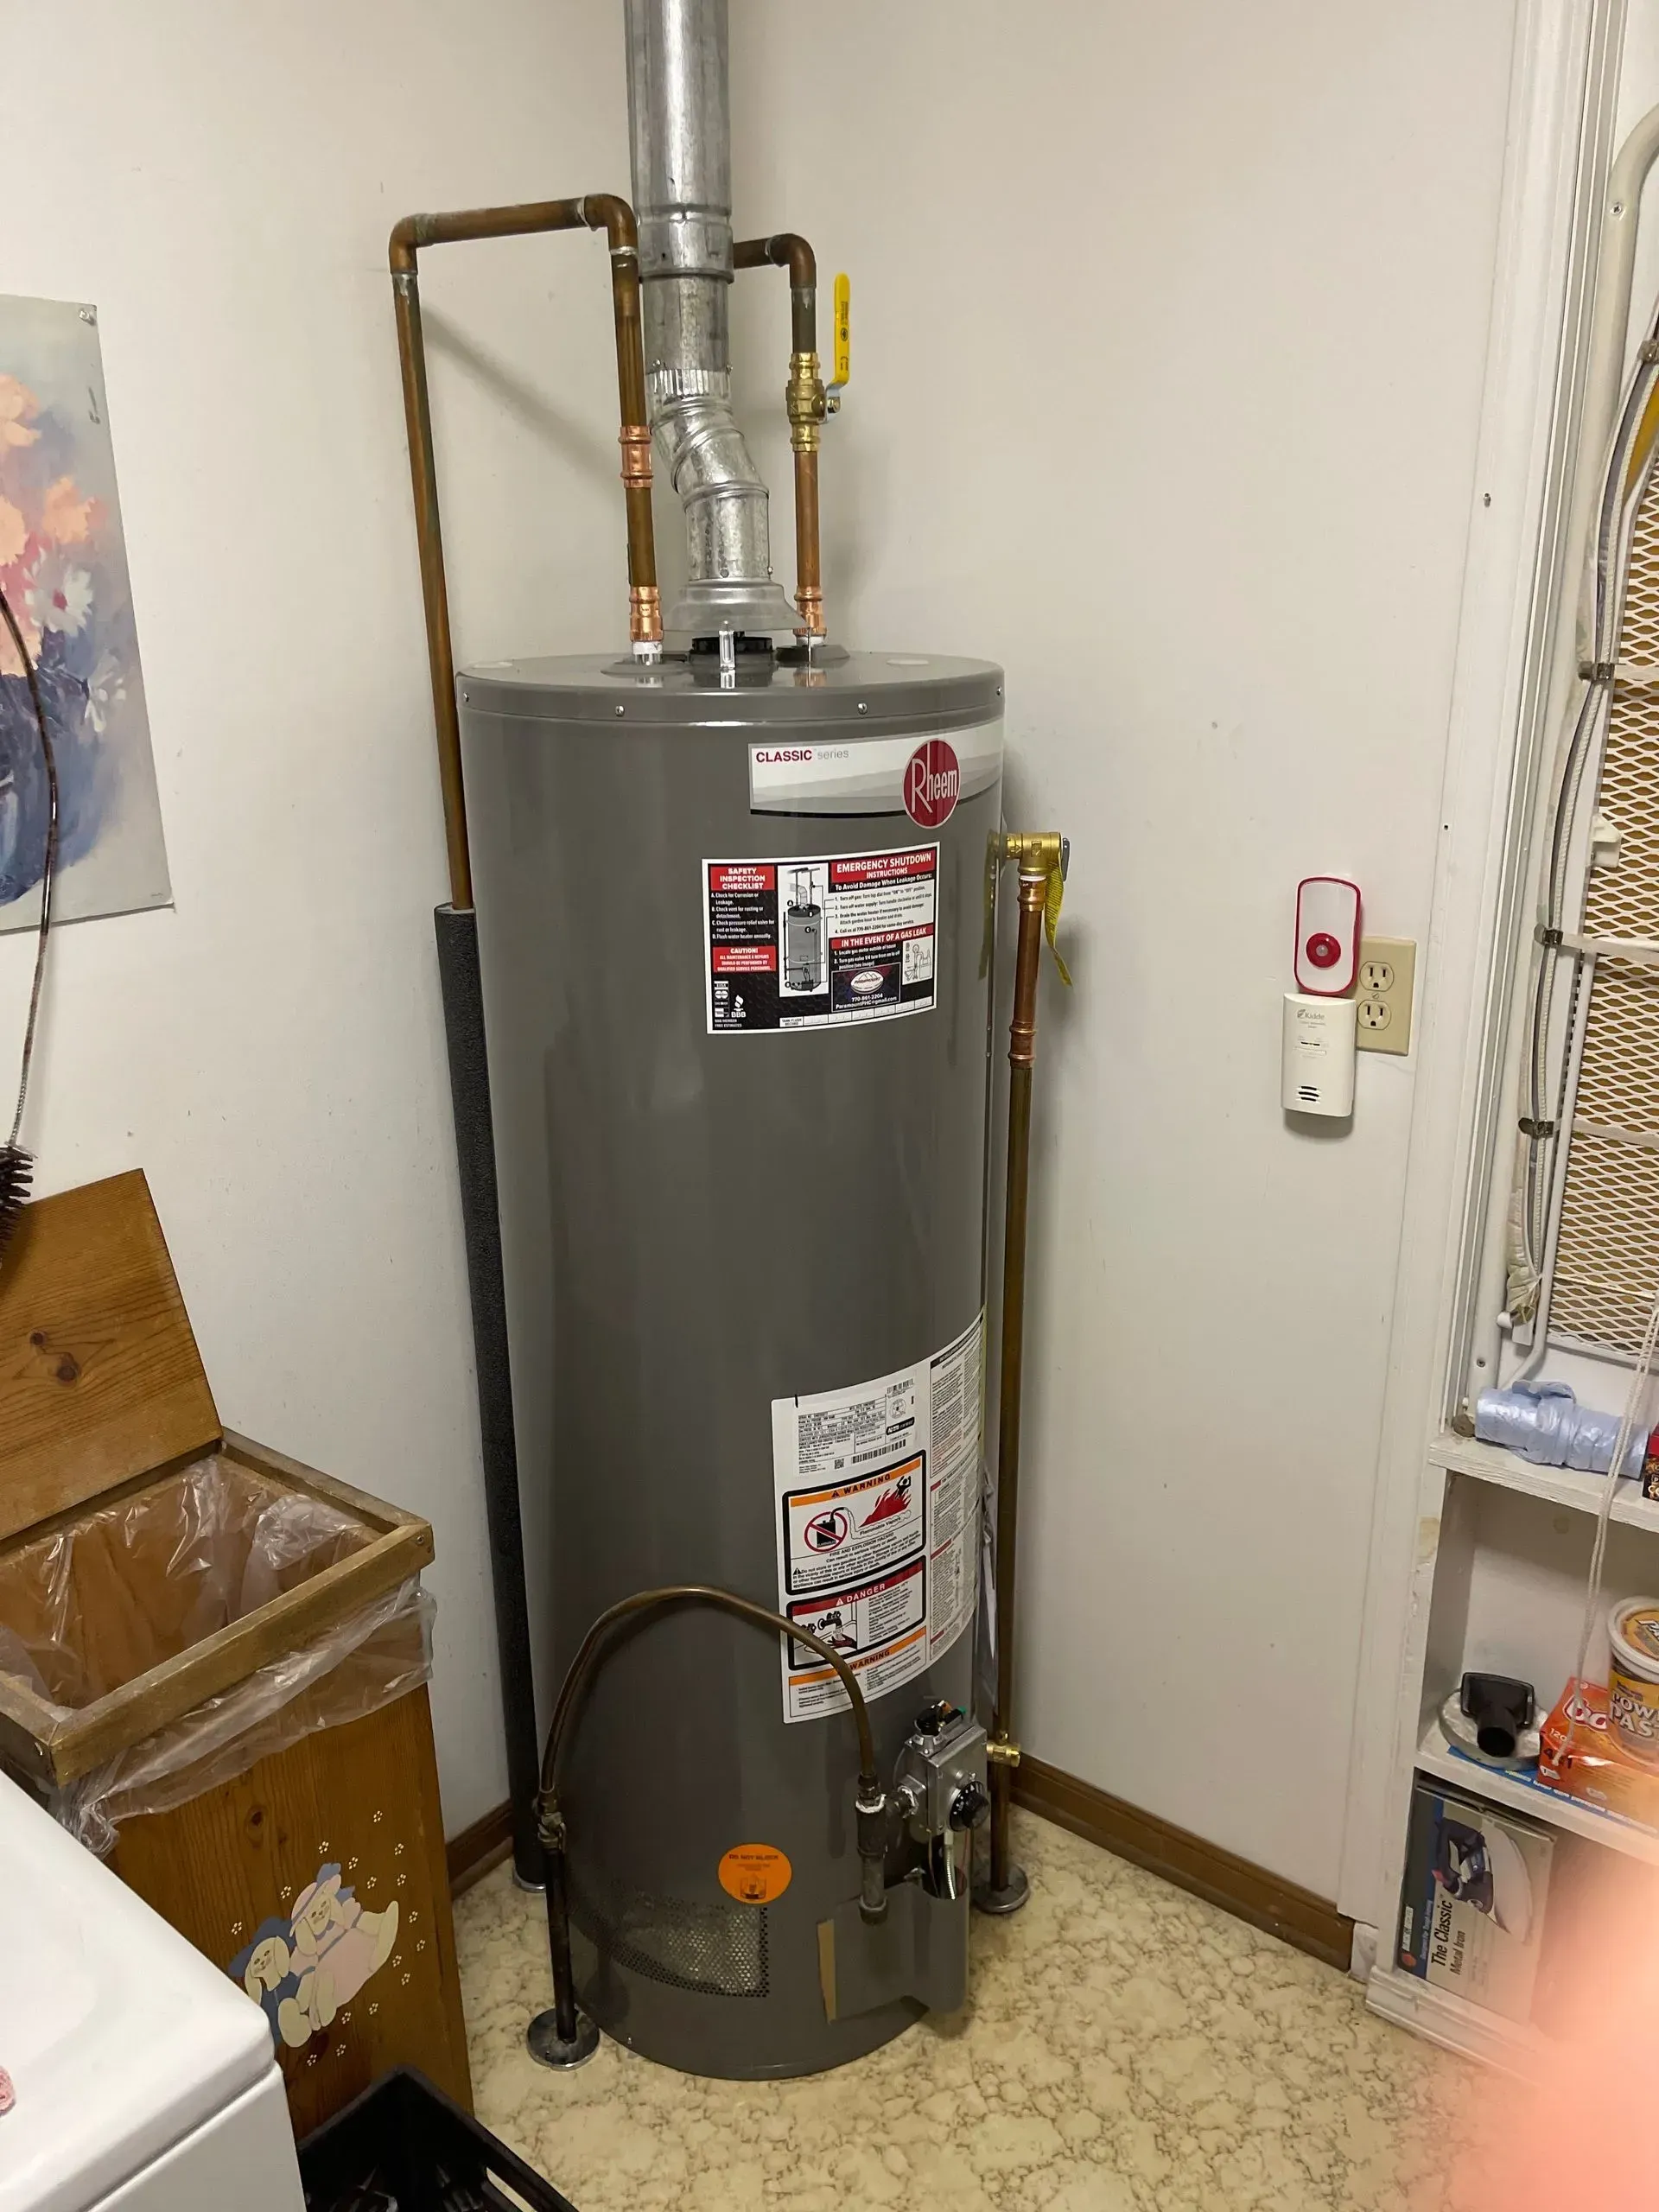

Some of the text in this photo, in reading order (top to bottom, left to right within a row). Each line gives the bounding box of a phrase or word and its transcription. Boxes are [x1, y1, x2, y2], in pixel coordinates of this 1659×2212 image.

[756, 749, 849, 763] CLASSIC series
[912, 741, 957, 813] Rheem
[836, 852, 931, 873] EMERGENCY SHUTDOWN
[867, 868, 907, 879] INSTRUCTIONS
[841, 939, 849, 948] IN
[850, 938, 863, 946] THE
[864, 935, 885, 944] EVENT
[886, 933, 894, 942] OF
[900, 930, 912, 938] GAS
[913, 926, 927, 937] LEAK
[843, 1474, 890, 1494] WARNING
[852, 1539, 876, 1551] EXPLOSION
[846, 1583, 886, 1603] DANGER
[849, 1649, 890, 1670] WARNING
[1612, 1693, 1659, 1722] POW
[1550, 1728, 1567, 1742] 120
[1431, 1900, 1452, 1967] The Classic
[1450, 1929, 1465, 1975] Metal Iron
